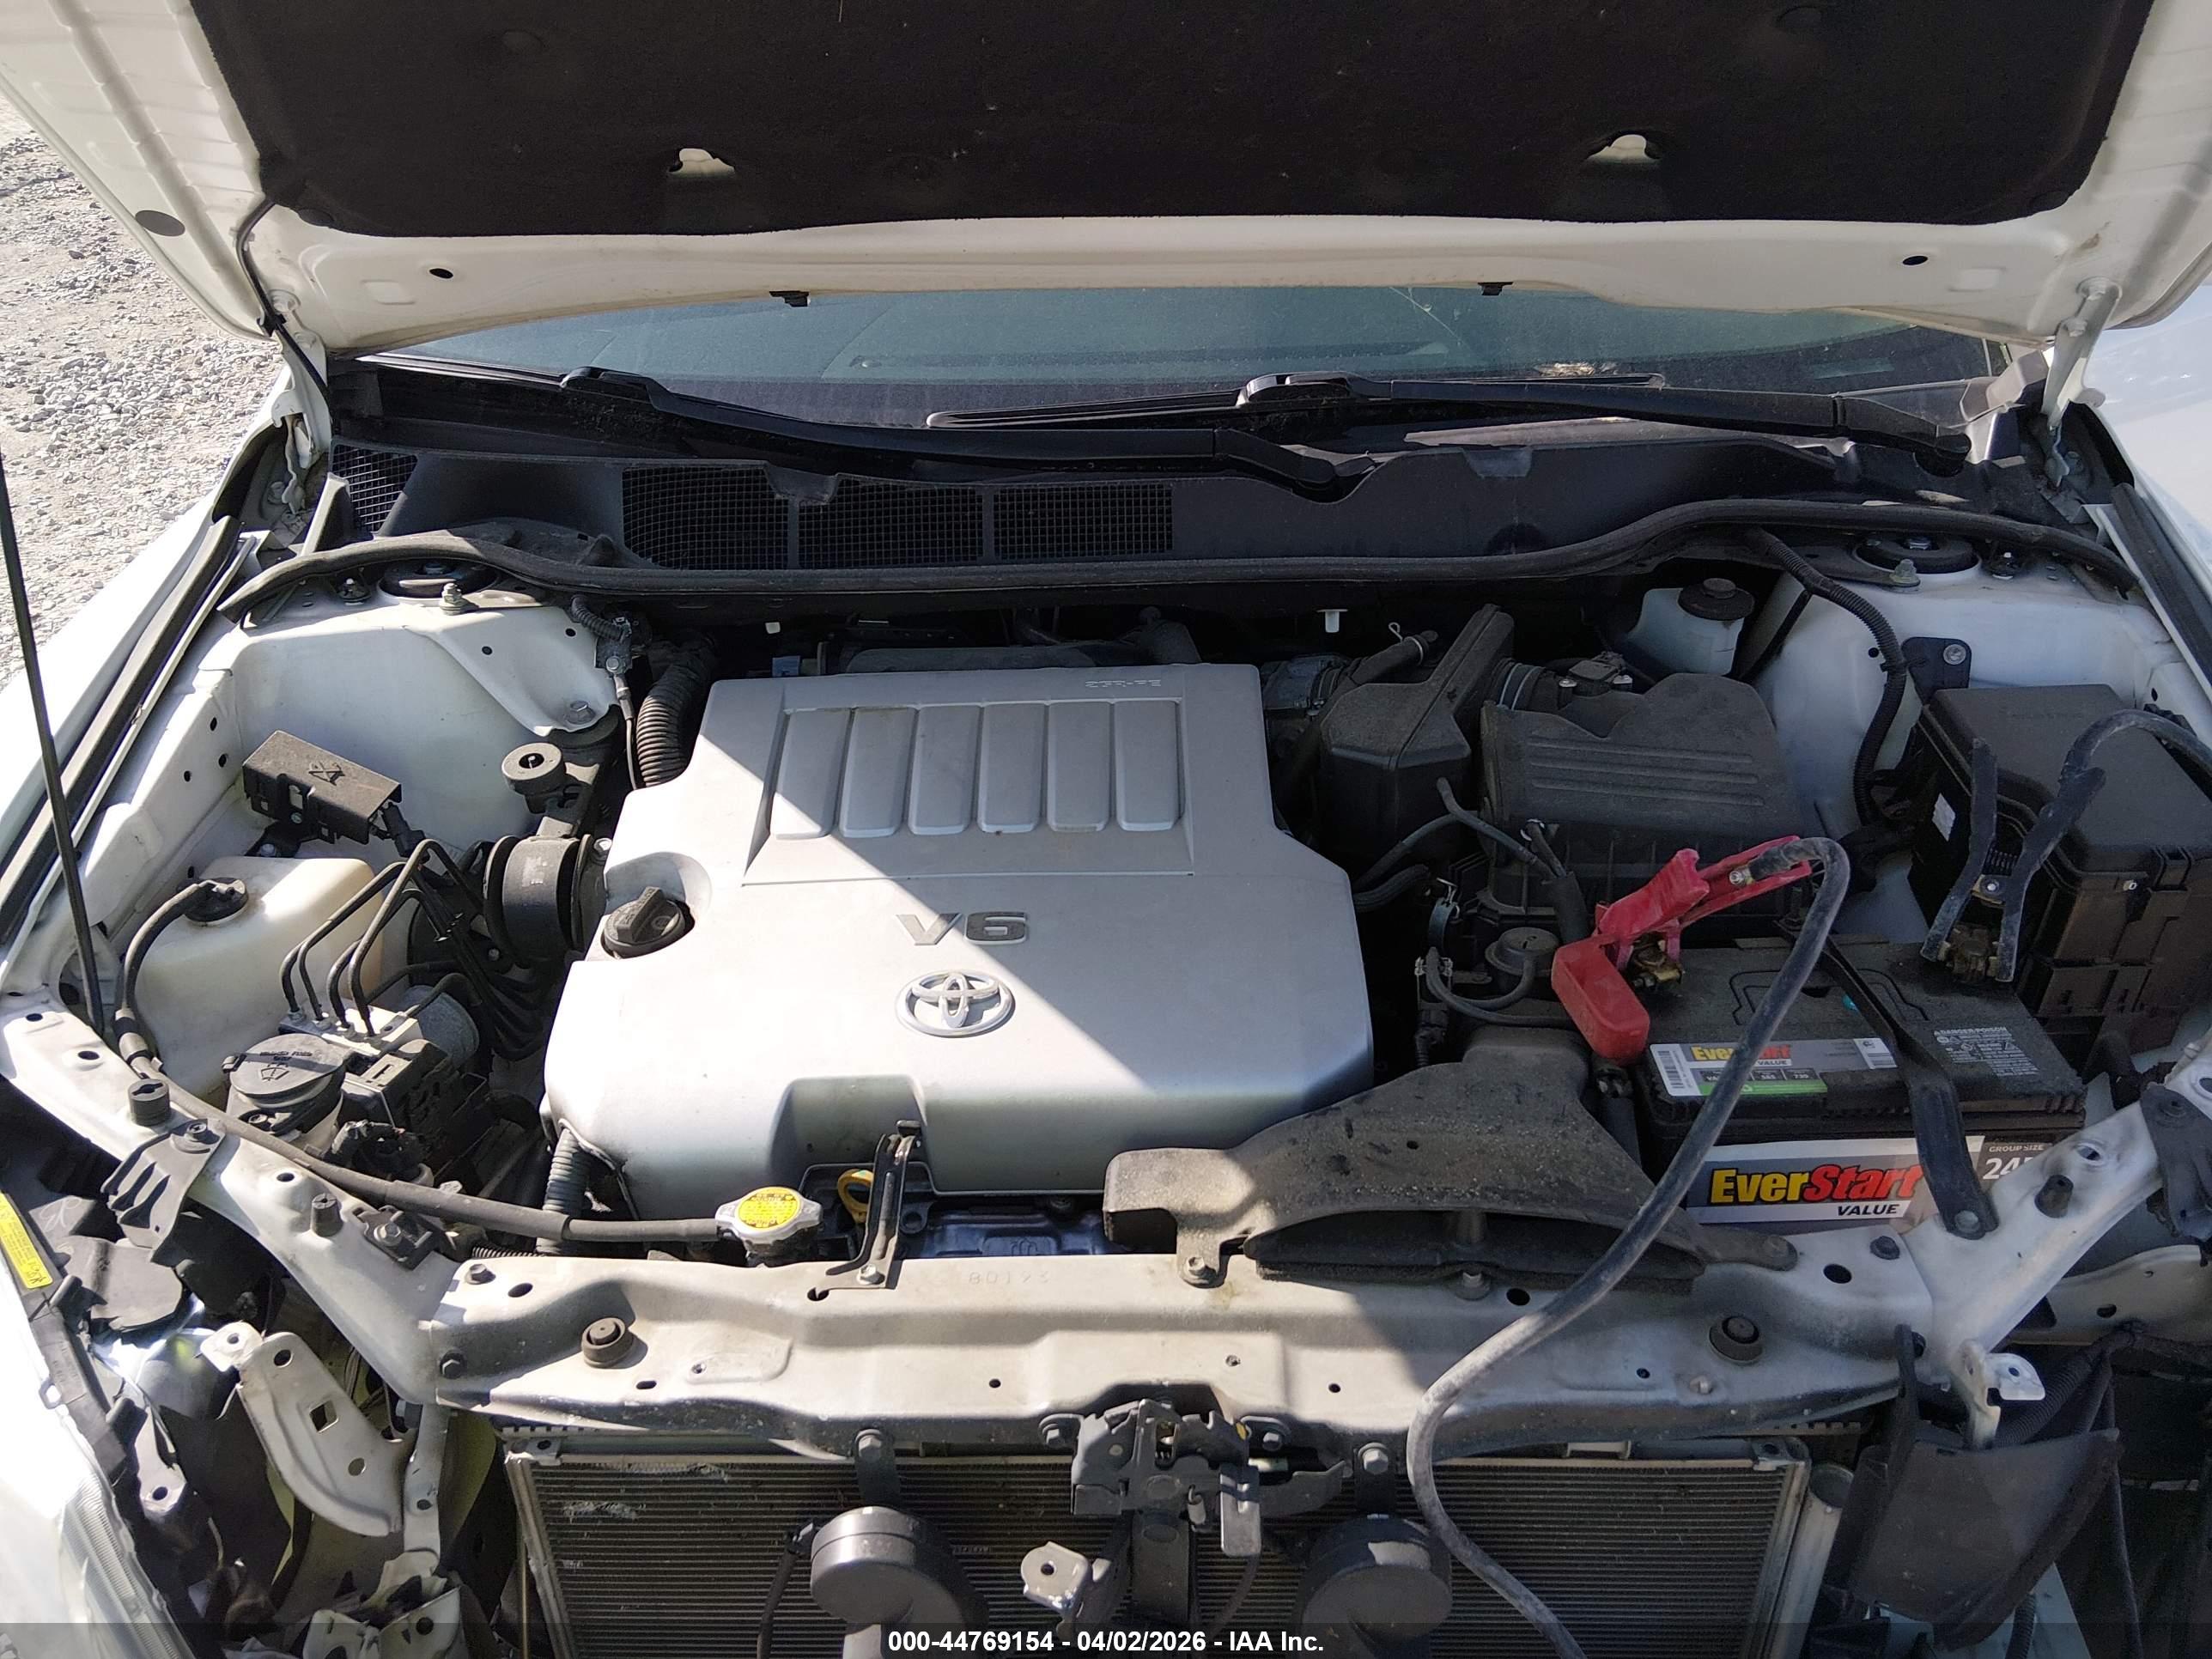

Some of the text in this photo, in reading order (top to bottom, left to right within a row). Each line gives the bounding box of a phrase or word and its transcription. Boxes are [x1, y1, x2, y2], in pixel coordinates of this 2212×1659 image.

[895, 911, 1028, 946] V6
[1989, 1145, 2023, 1153] GROUP
[1982, 1156, 2034, 1180] 24
[1710, 1163, 1925, 1204] EverStart
[1836, 1203, 1900, 1217] VALUE
